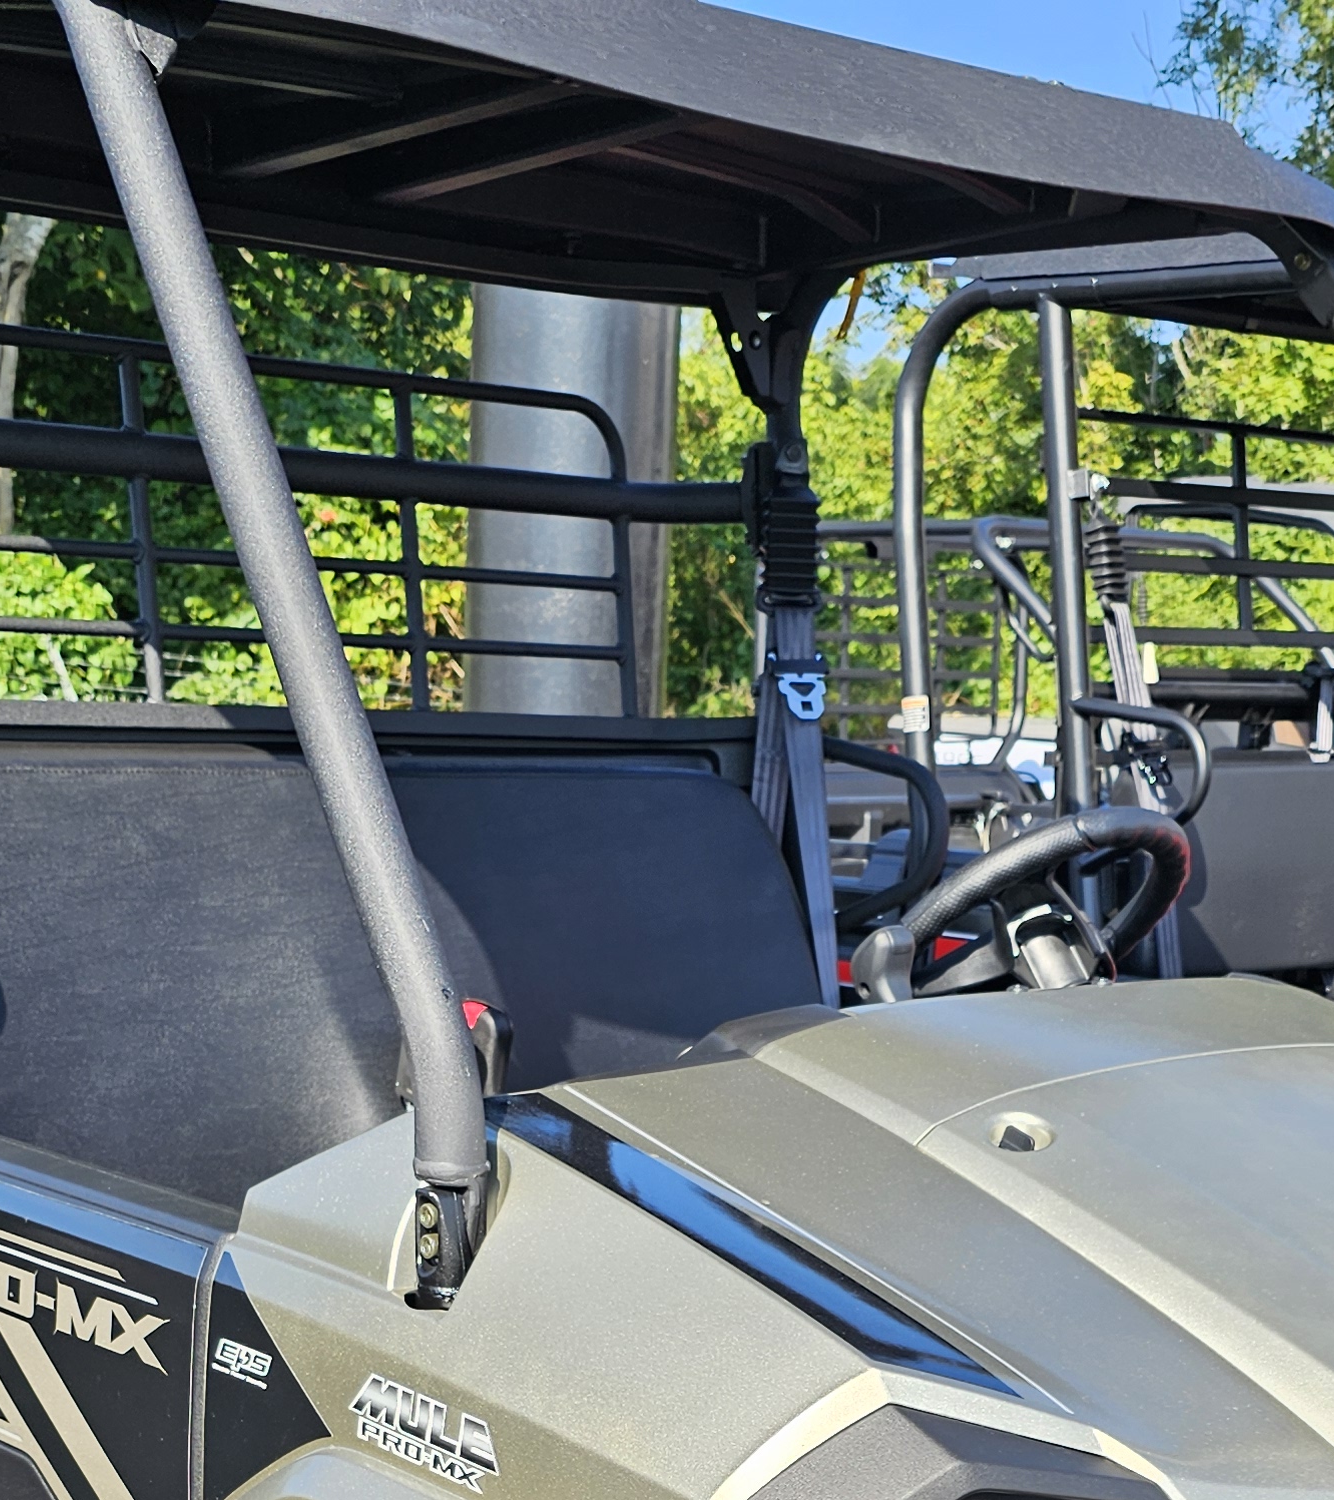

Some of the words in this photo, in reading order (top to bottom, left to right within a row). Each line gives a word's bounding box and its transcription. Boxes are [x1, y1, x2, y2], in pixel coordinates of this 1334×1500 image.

[215, 1338, 273, 1377] EPS
[348, 1373, 500, 1477] MULE
[357, 1415, 486, 1495] PRO-MX
